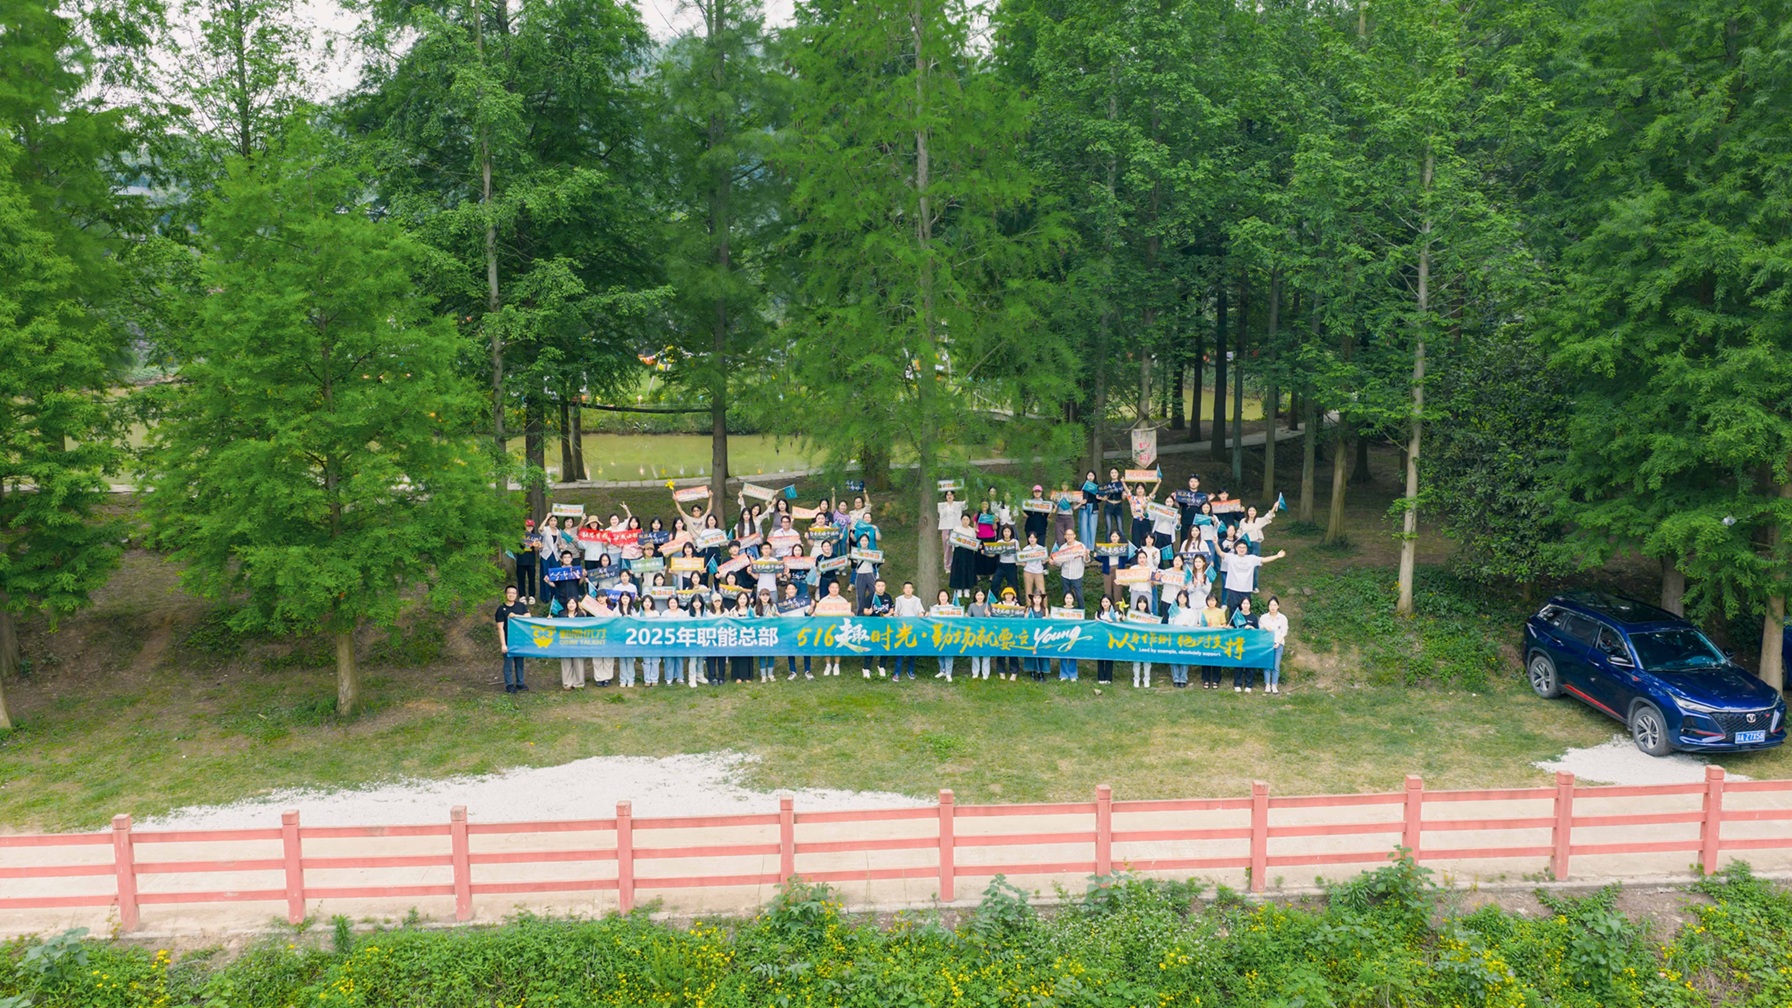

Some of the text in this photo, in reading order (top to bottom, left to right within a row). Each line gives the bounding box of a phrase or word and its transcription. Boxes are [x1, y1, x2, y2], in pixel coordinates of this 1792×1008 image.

[625, 627, 779, 648] 2025年职能总部
